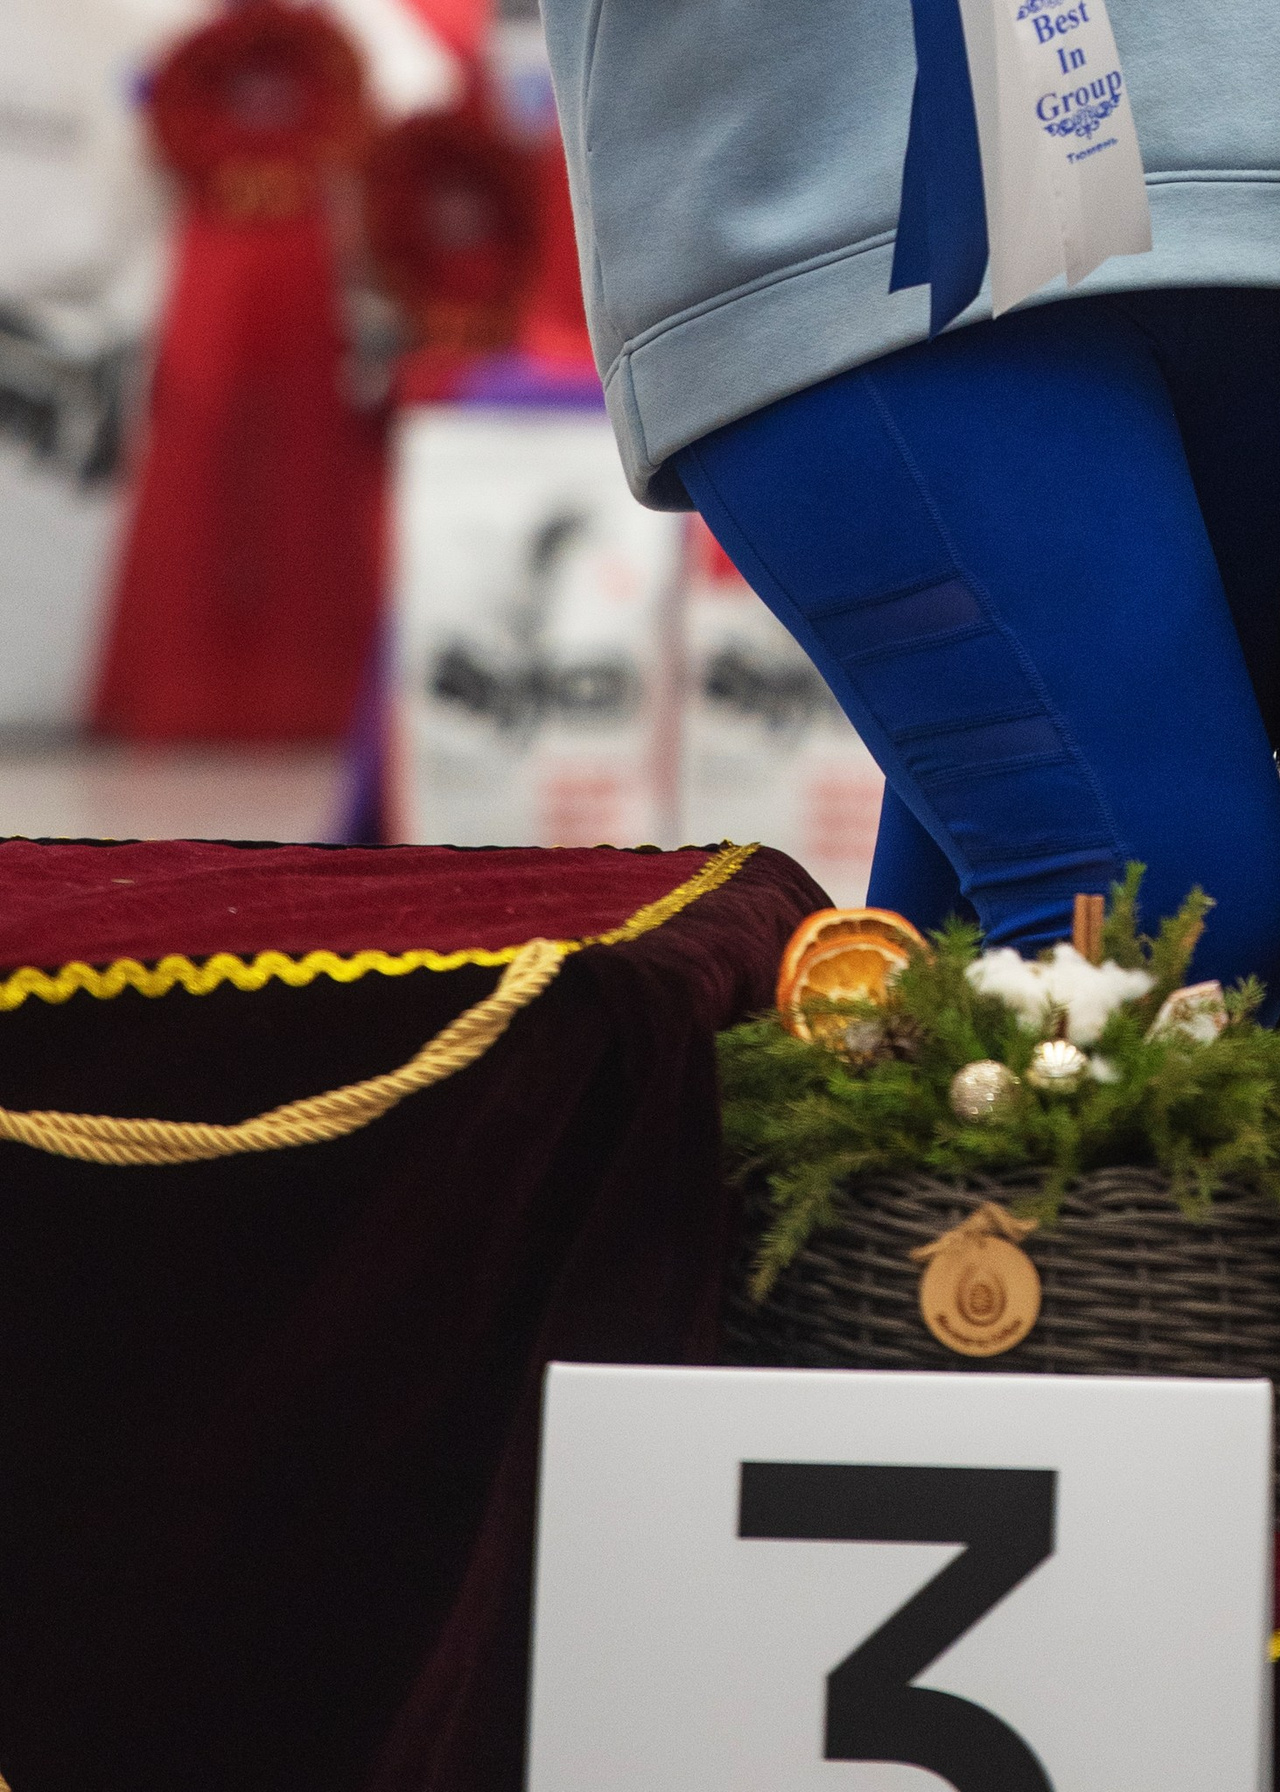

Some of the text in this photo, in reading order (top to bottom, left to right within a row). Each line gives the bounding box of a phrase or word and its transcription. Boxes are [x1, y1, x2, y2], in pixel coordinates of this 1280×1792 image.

[1032, 0, 1089, 44] Best
[1057, 48, 1086, 74] In
[1036, 70, 1122, 121] Group
[737, 1461, 1058, 1792] 3
